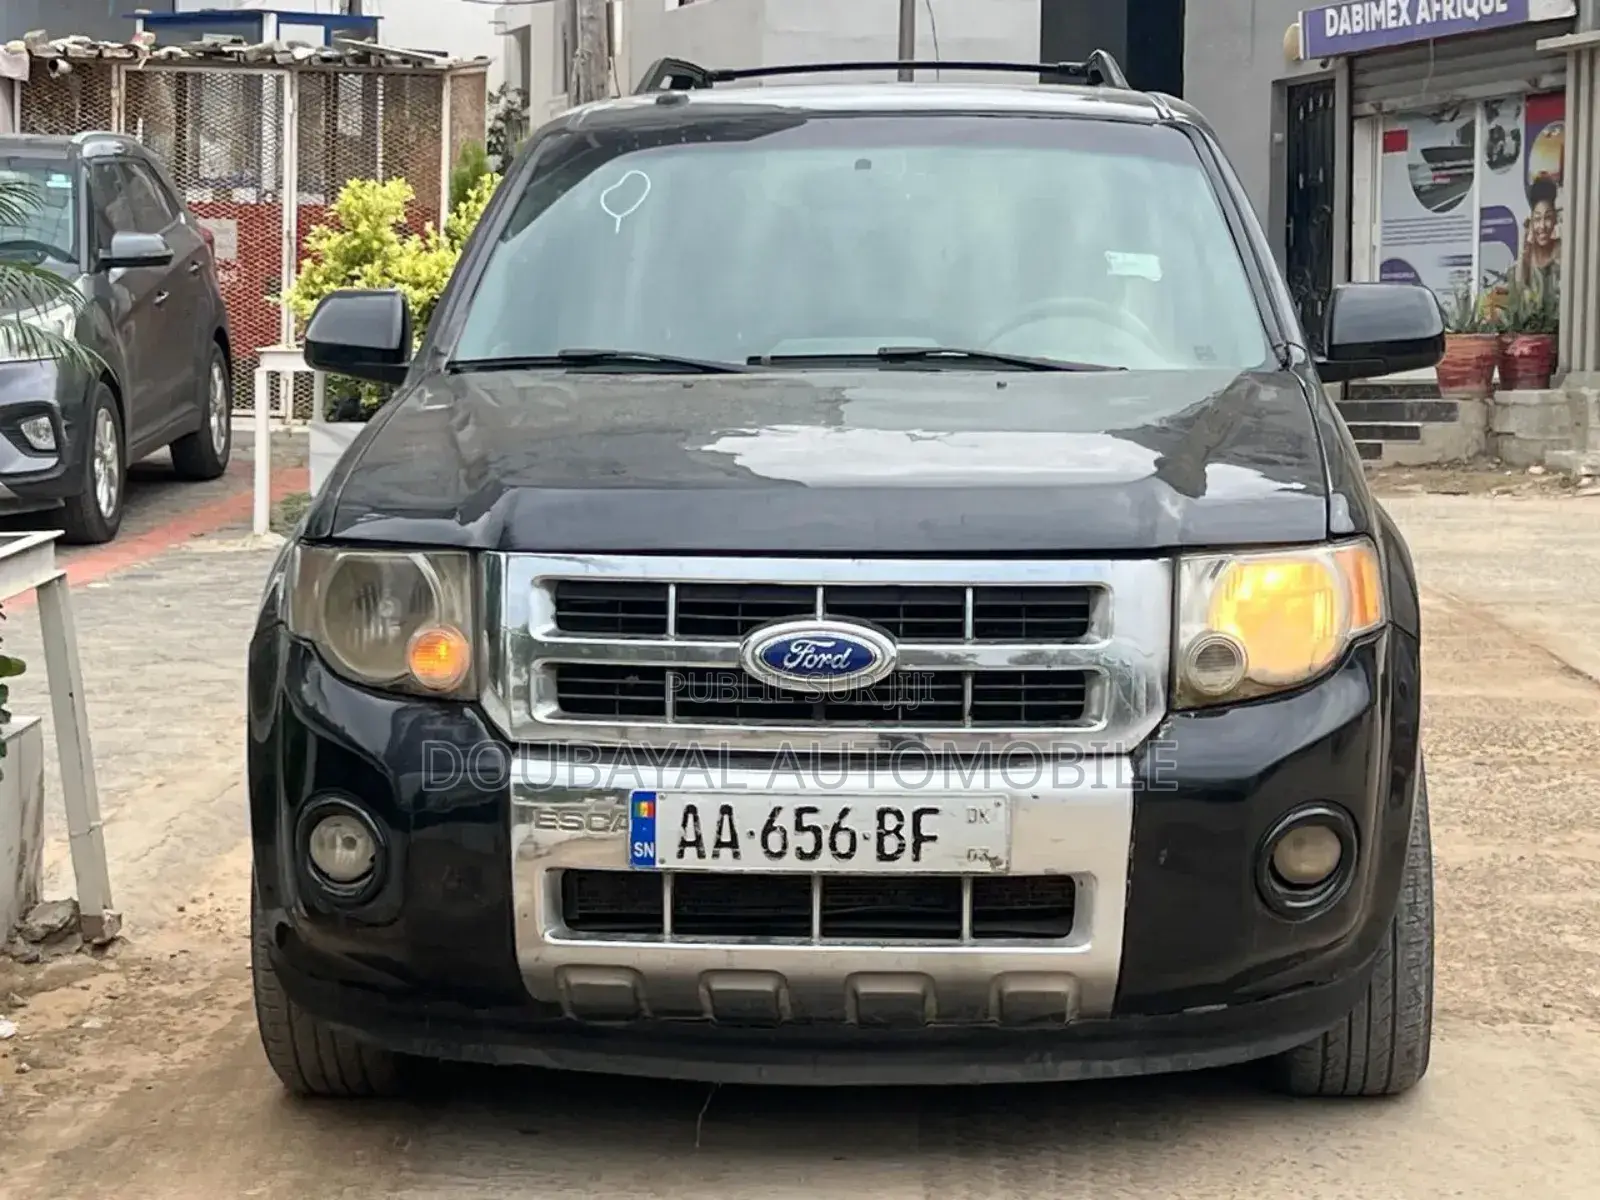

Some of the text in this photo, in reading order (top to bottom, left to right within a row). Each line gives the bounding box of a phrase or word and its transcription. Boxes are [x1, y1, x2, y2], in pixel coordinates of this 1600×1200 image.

[1325, 0, 1412, 37] DABIMEX
[783, 639, 853, 669] Ford
[633, 841, 655, 858] SN
